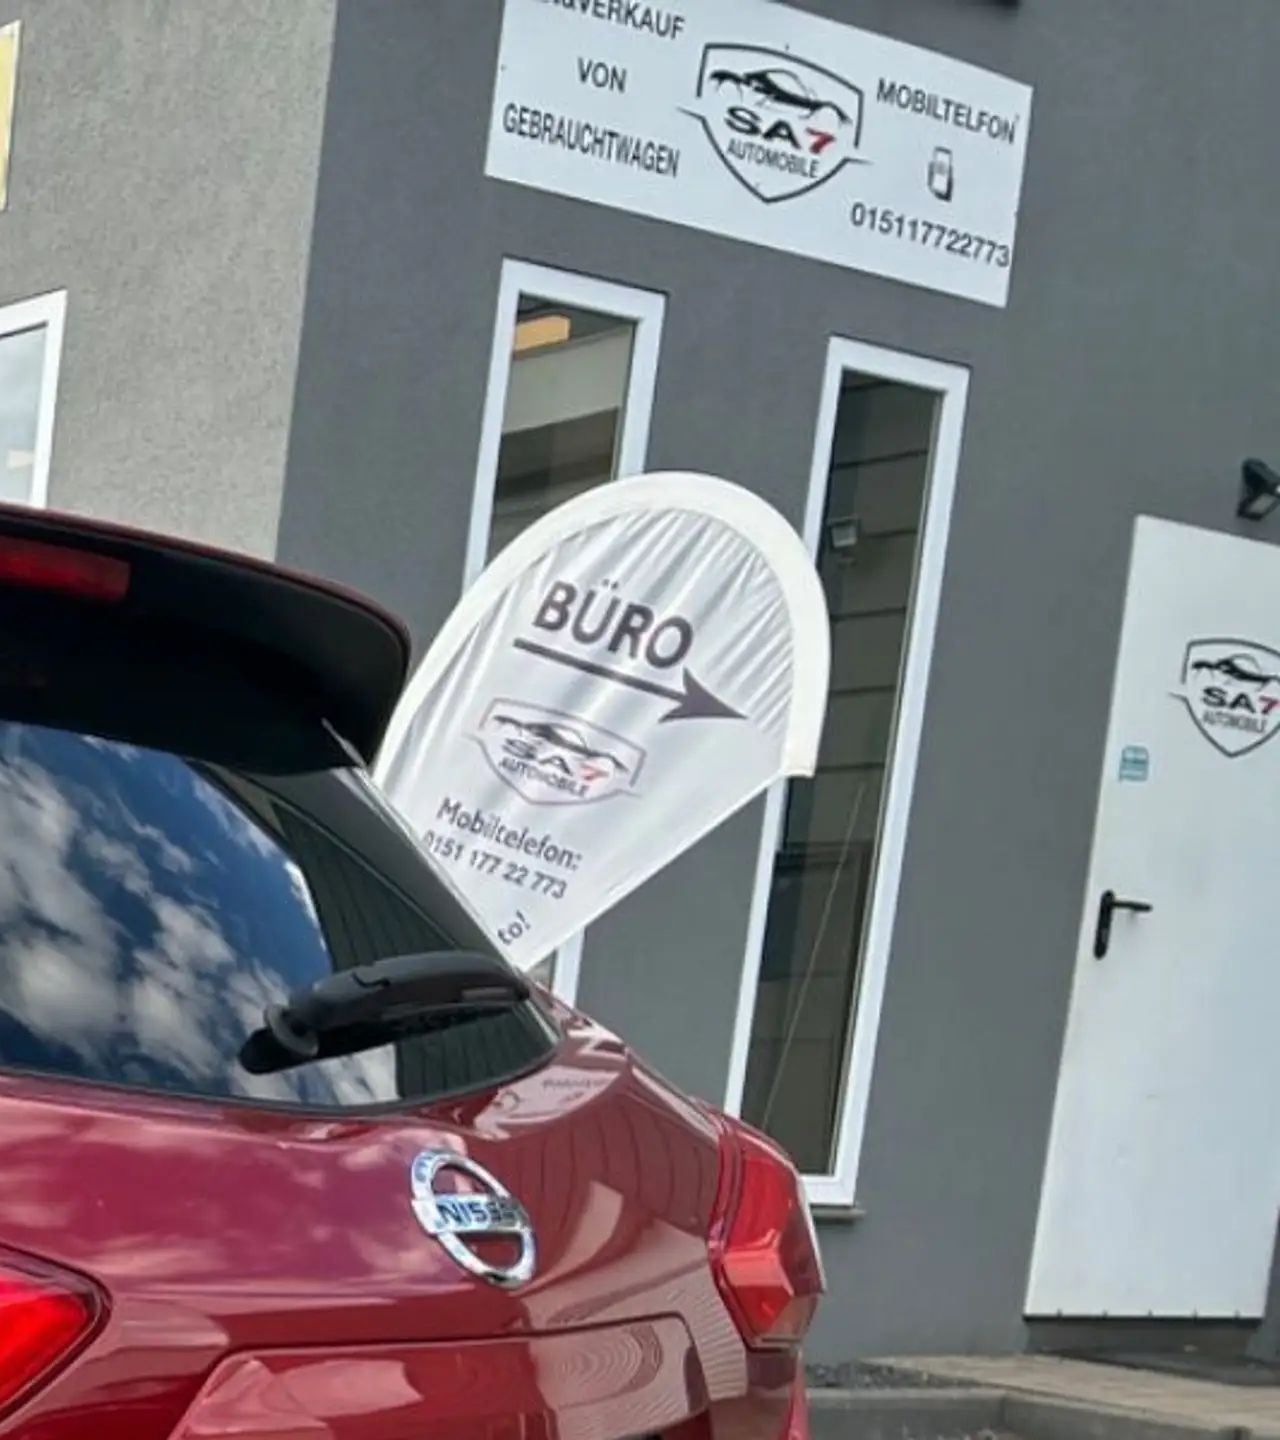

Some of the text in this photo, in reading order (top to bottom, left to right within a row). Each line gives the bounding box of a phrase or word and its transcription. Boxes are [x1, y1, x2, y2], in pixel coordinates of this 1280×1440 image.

[577, 56, 628, 95] VON
[502, 102, 682, 179] GEBRAUCHTWAGEN
[724, 105, 837, 155] SA7
[876, 77, 1017, 145] MOBILTELFON
[727, 138, 821, 179] AUTOMOBILE
[850, 201, 1010, 268] 015117722773
[531, 577, 695, 669] BÜRO
[423, 829, 569, 900] 0151 177 22 773
[436, 797, 584, 872] Mobiltelefon:
